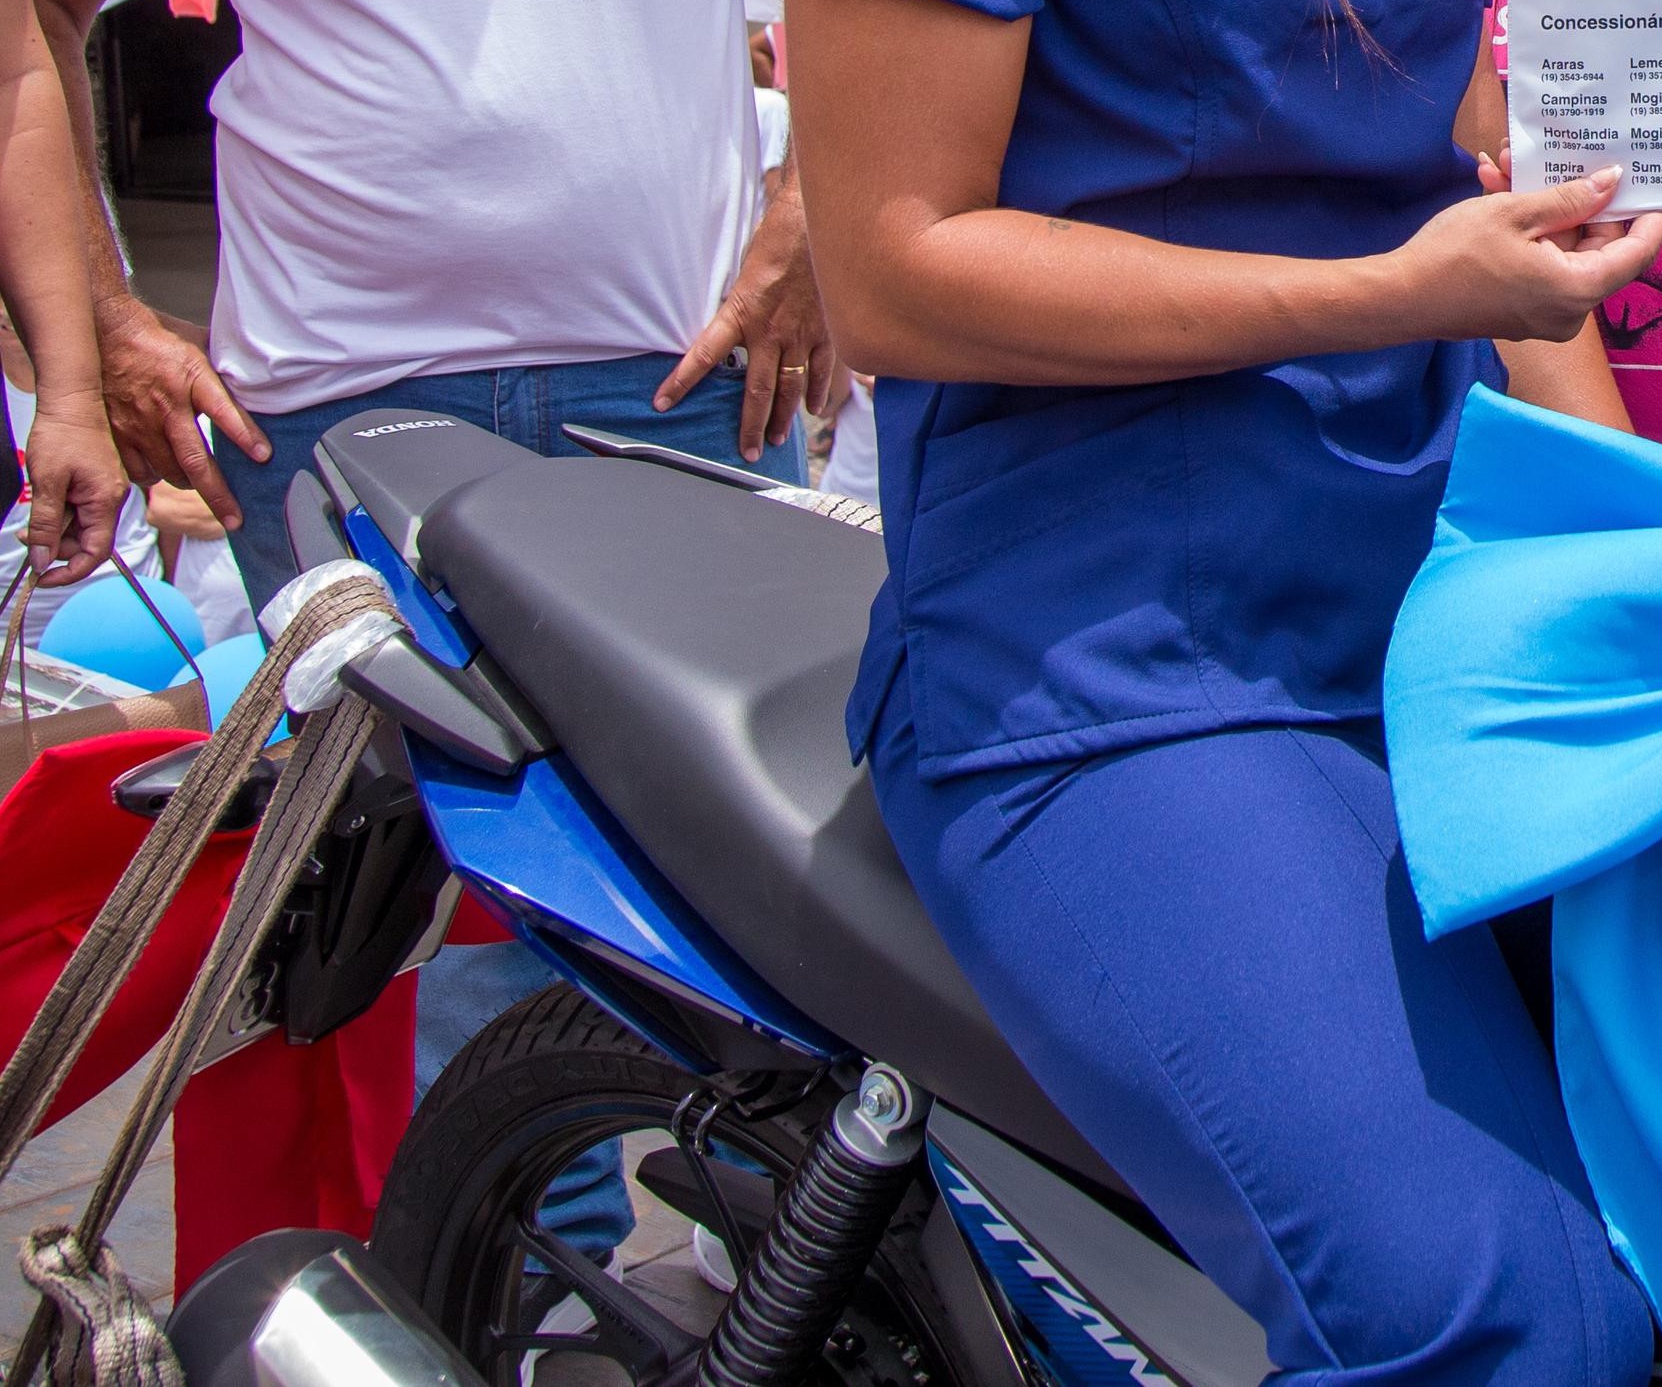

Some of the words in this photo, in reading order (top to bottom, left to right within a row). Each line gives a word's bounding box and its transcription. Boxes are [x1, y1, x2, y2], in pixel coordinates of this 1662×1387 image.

[1541, 59, 1584, 70] Araras
[1541, 73, 1558, 82] (19)
[1560, 73, 1604, 81] 3543-6944
[1630, 72, 1646, 81] (19)
[1541, 93, 1607, 107] Campinas
[1541, 109, 1558, 117] (19)
[1630, 107, 1647, 116] (19)
[1544, 127, 1619, 140] Hortolândia
[1544, 141, 1561, 151] (19)
[1631, 142, 1648, 151] (19)
[1545, 162, 1584, 174] Itapira
[1544, 176, 1561, 185] (19)
[1632, 176, 1648, 185] (19)
[353, 419, 457, 439] HONDA
